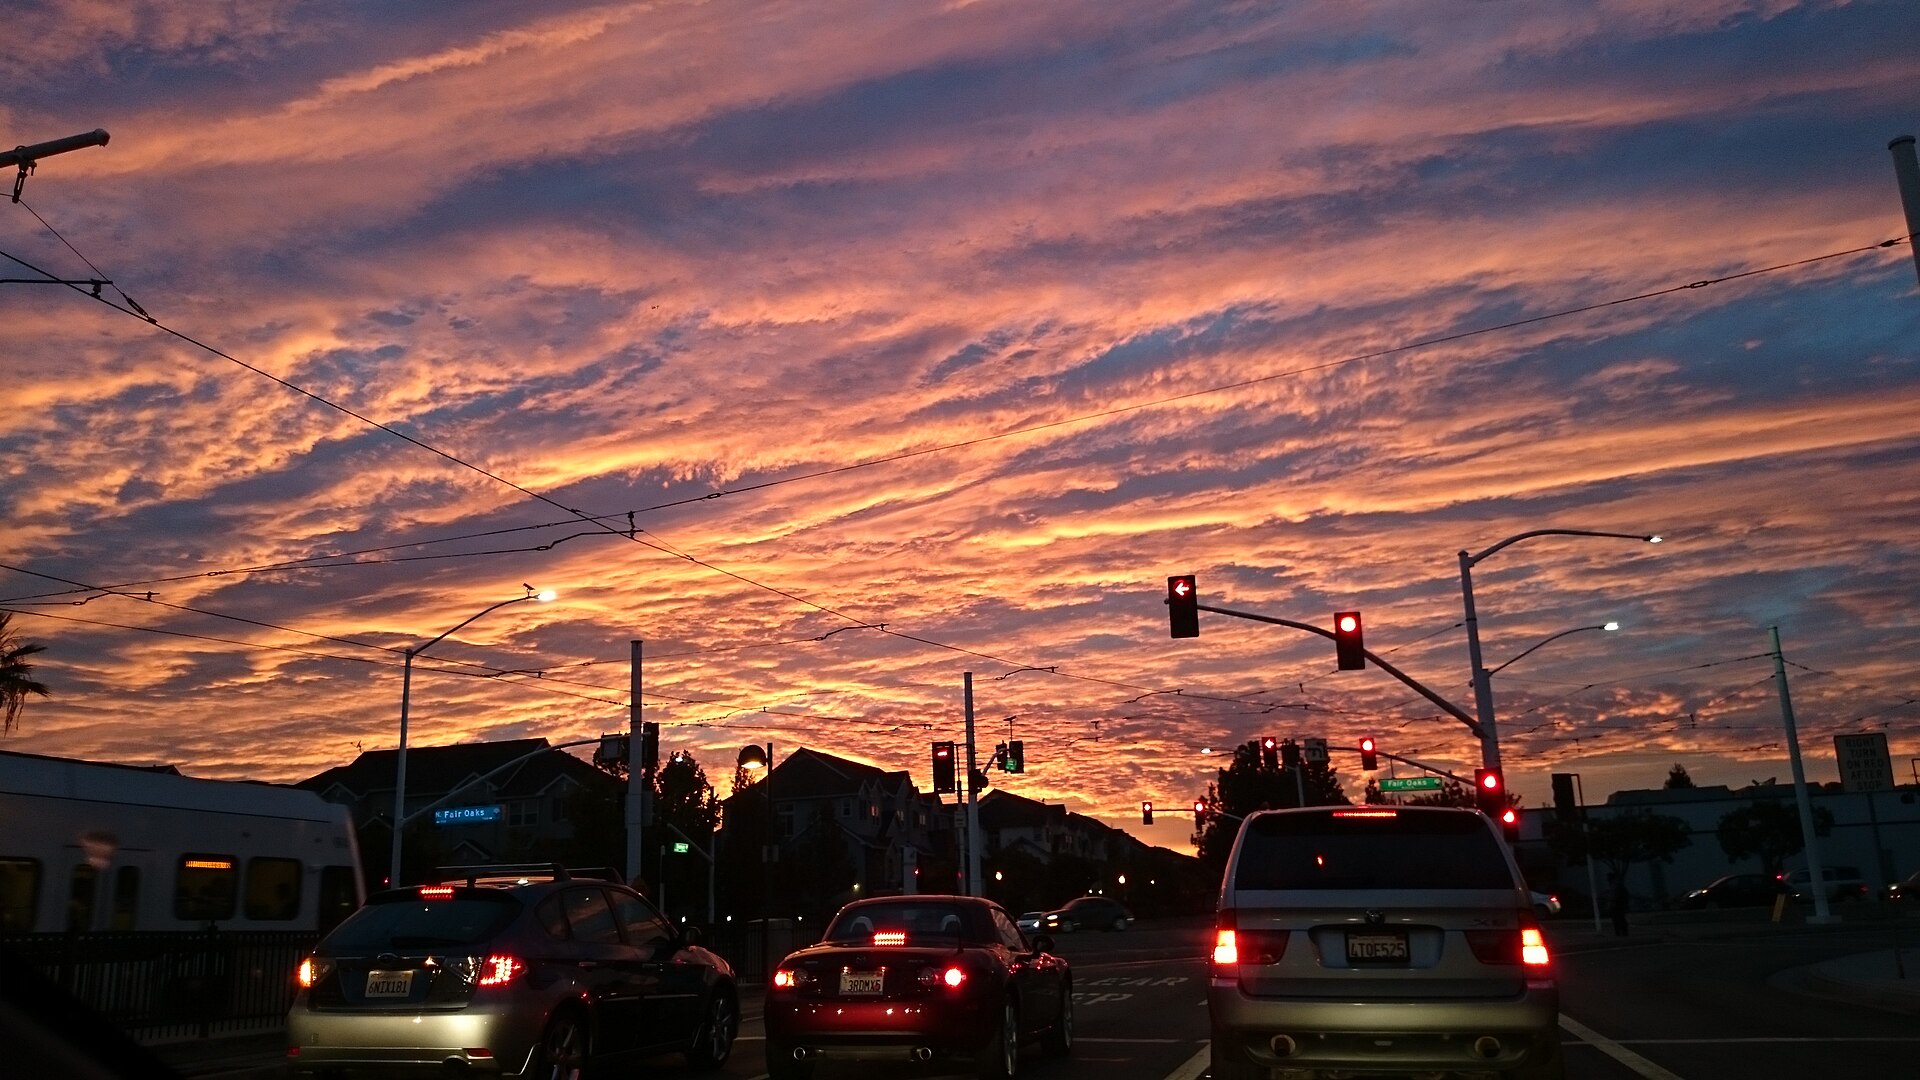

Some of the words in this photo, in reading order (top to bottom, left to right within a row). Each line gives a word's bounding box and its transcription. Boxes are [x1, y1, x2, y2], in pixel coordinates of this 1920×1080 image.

[1846, 737, 1875, 747] RIGHT
[1850, 748, 1877, 758] TURN
[1847, 759, 1860, 769] ON
[1864, 758, 1884, 769] RED
[1851, 769, 1882, 780] AFTER
[1856, 780, 1882, 791] STOP
[444, 810, 462, 818] Fair
[464, 809, 485, 817] Oaks
[368, 980, 408, 994] 6NIX181
